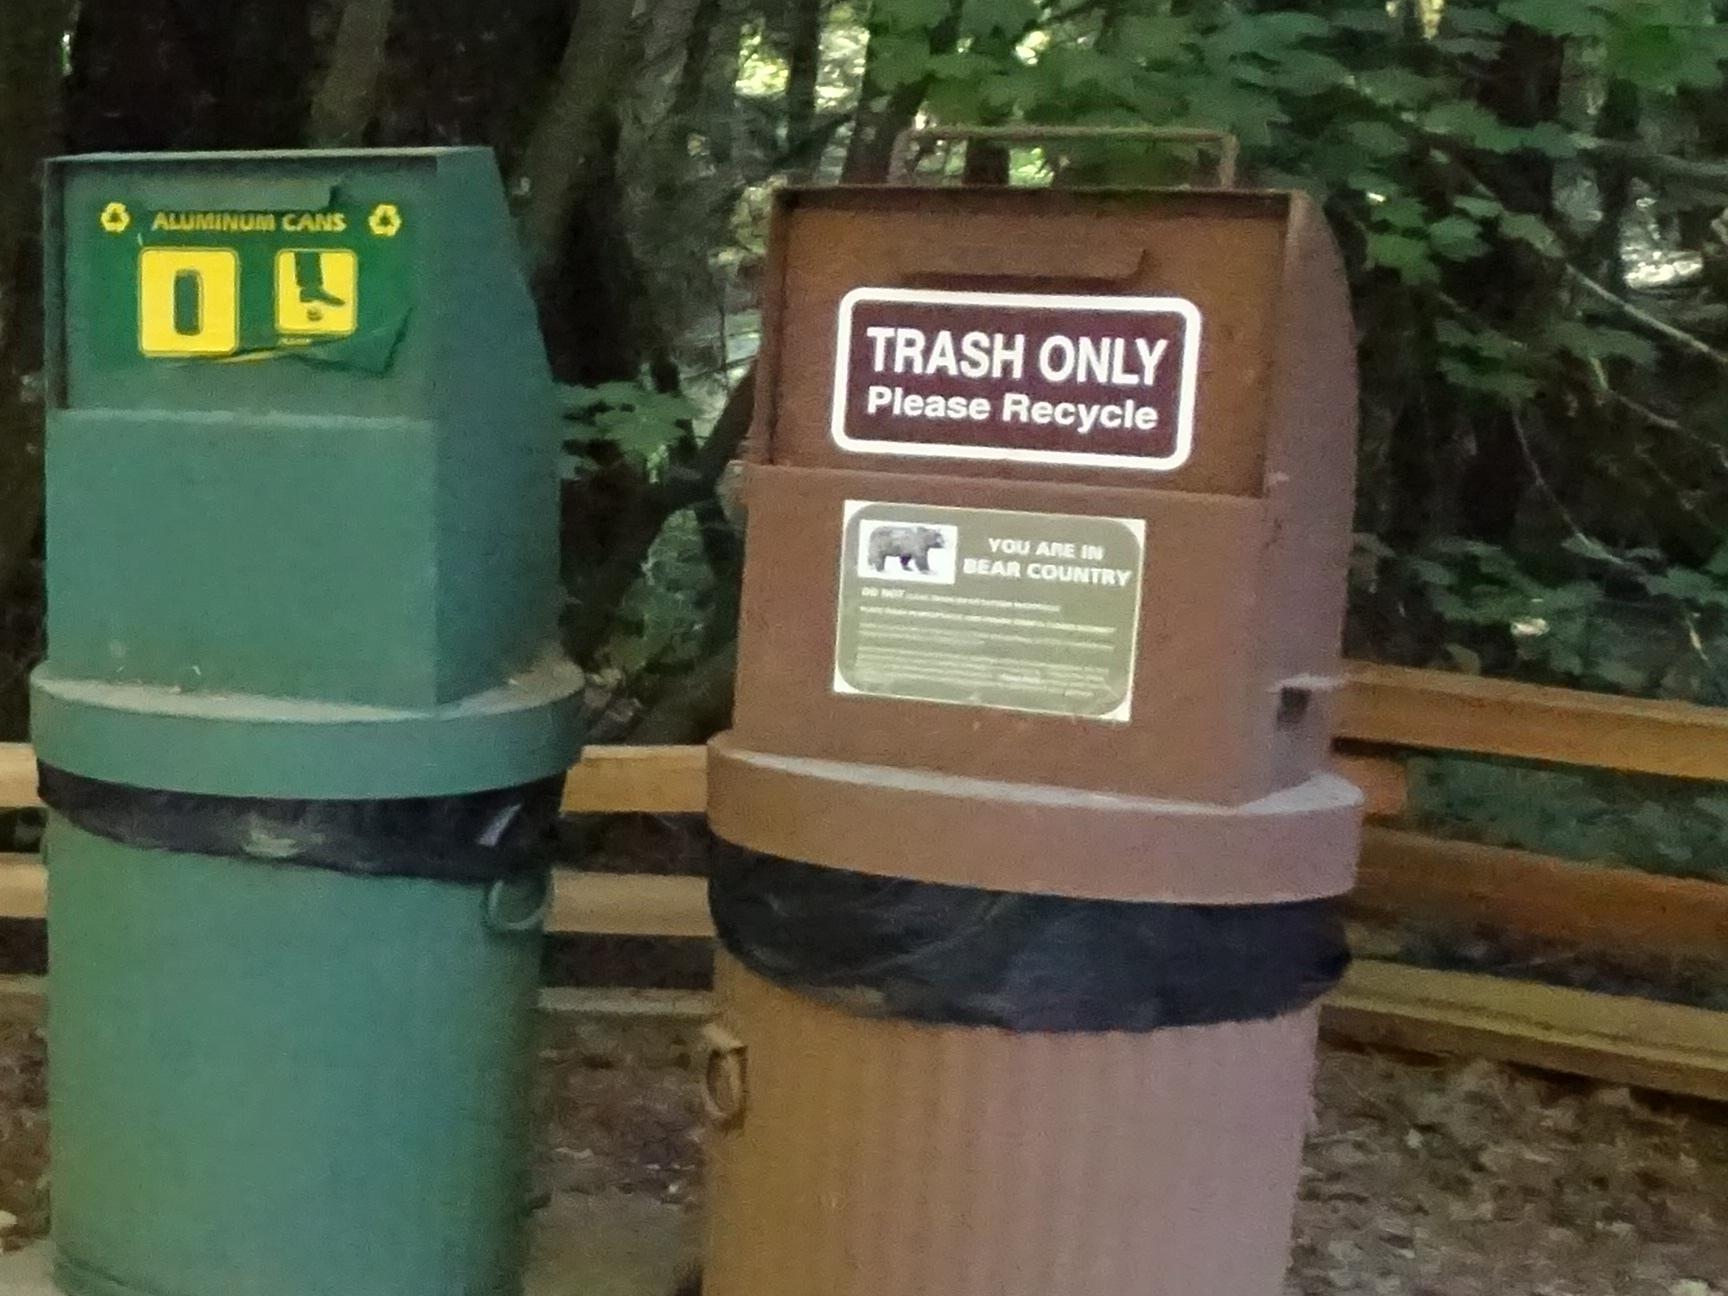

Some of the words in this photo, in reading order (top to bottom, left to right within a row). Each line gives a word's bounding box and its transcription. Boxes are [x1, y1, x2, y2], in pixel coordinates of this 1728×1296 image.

[151, 210, 276, 232] ALUMINUM
[282, 212, 347, 233] CANS
[865, 326, 1026, 380] TRASH
[1038, 335, 1169, 386] ONLY
[866, 385, 992, 421] Please
[1001, 392, 1159, 434] Recycle
[988, 538, 1031, 555] YOU
[1035, 541, 1076, 559] ARE
[1080, 545, 1106, 562] IN
[963, 558, 1021, 578] BEAR
[1026, 563, 1133, 587] COUNTRY
